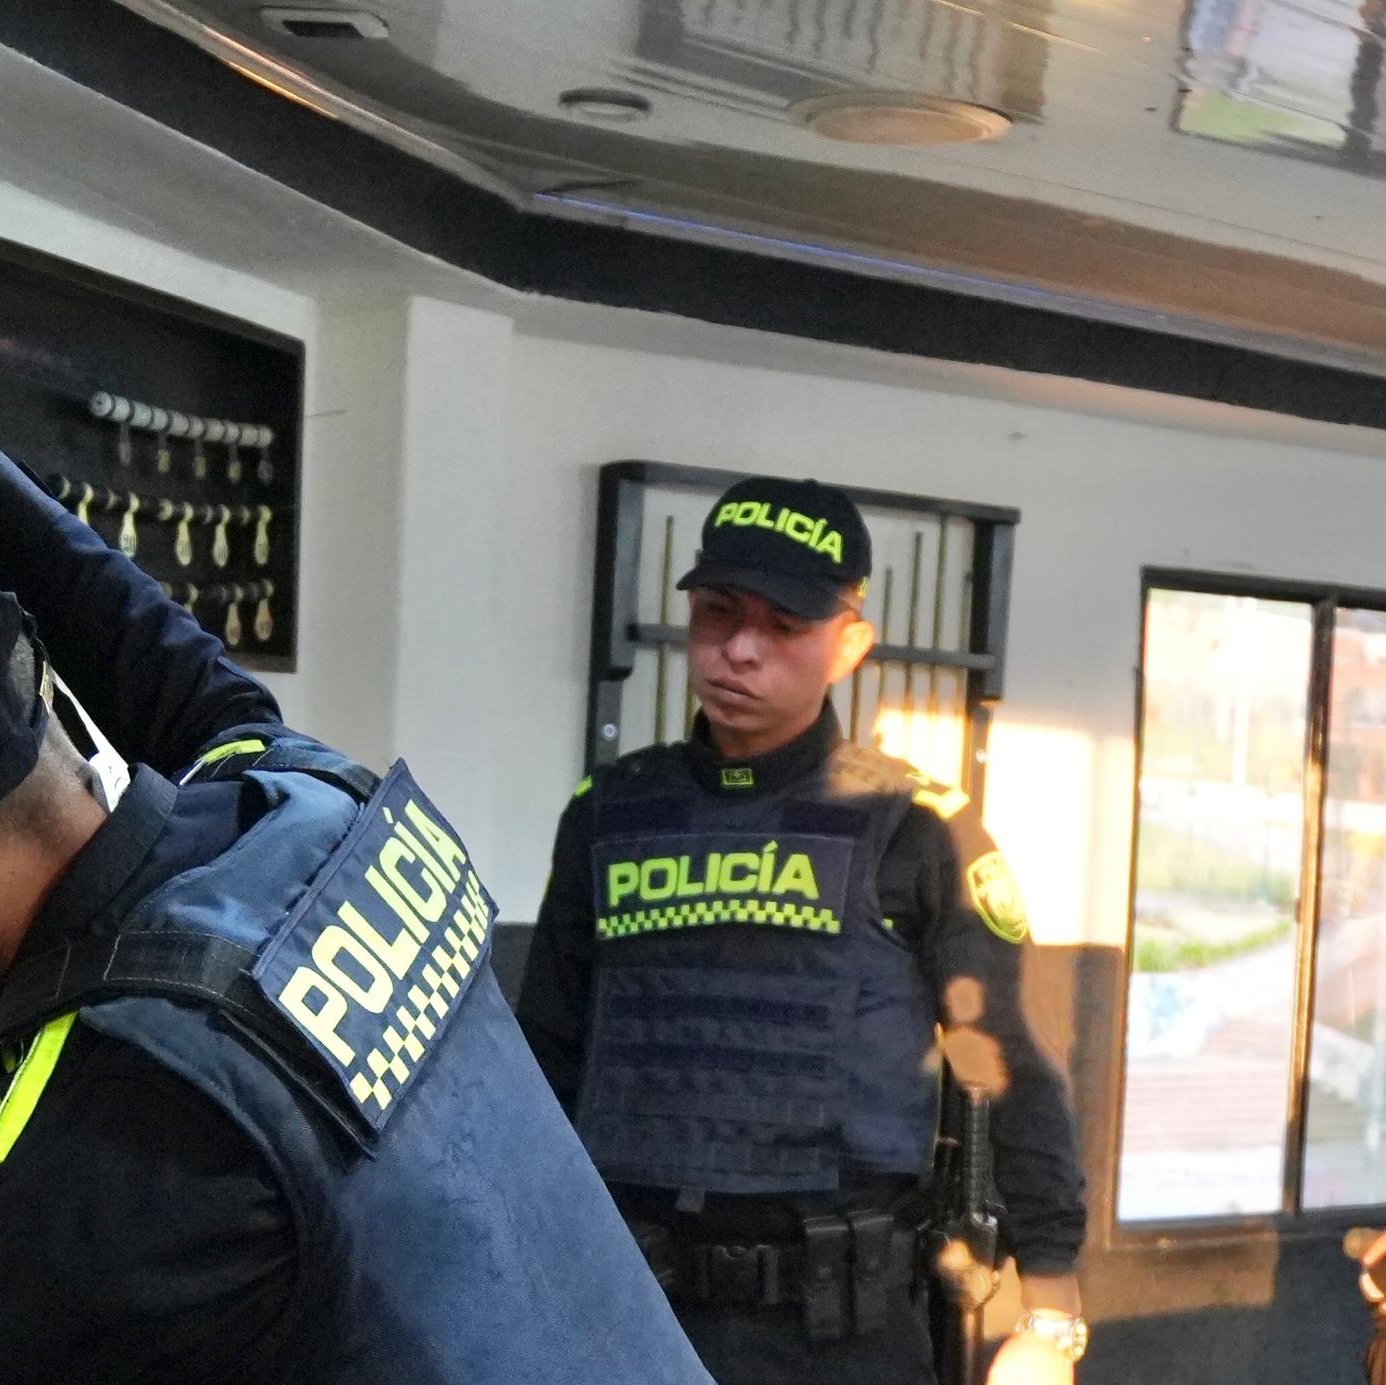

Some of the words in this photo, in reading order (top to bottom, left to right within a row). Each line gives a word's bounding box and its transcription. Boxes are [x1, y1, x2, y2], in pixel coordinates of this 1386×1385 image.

[715, 501, 843, 564] POLICÍA
[608, 841, 820, 906] POLICÍA
[278, 798, 467, 1067] POLICÍA
